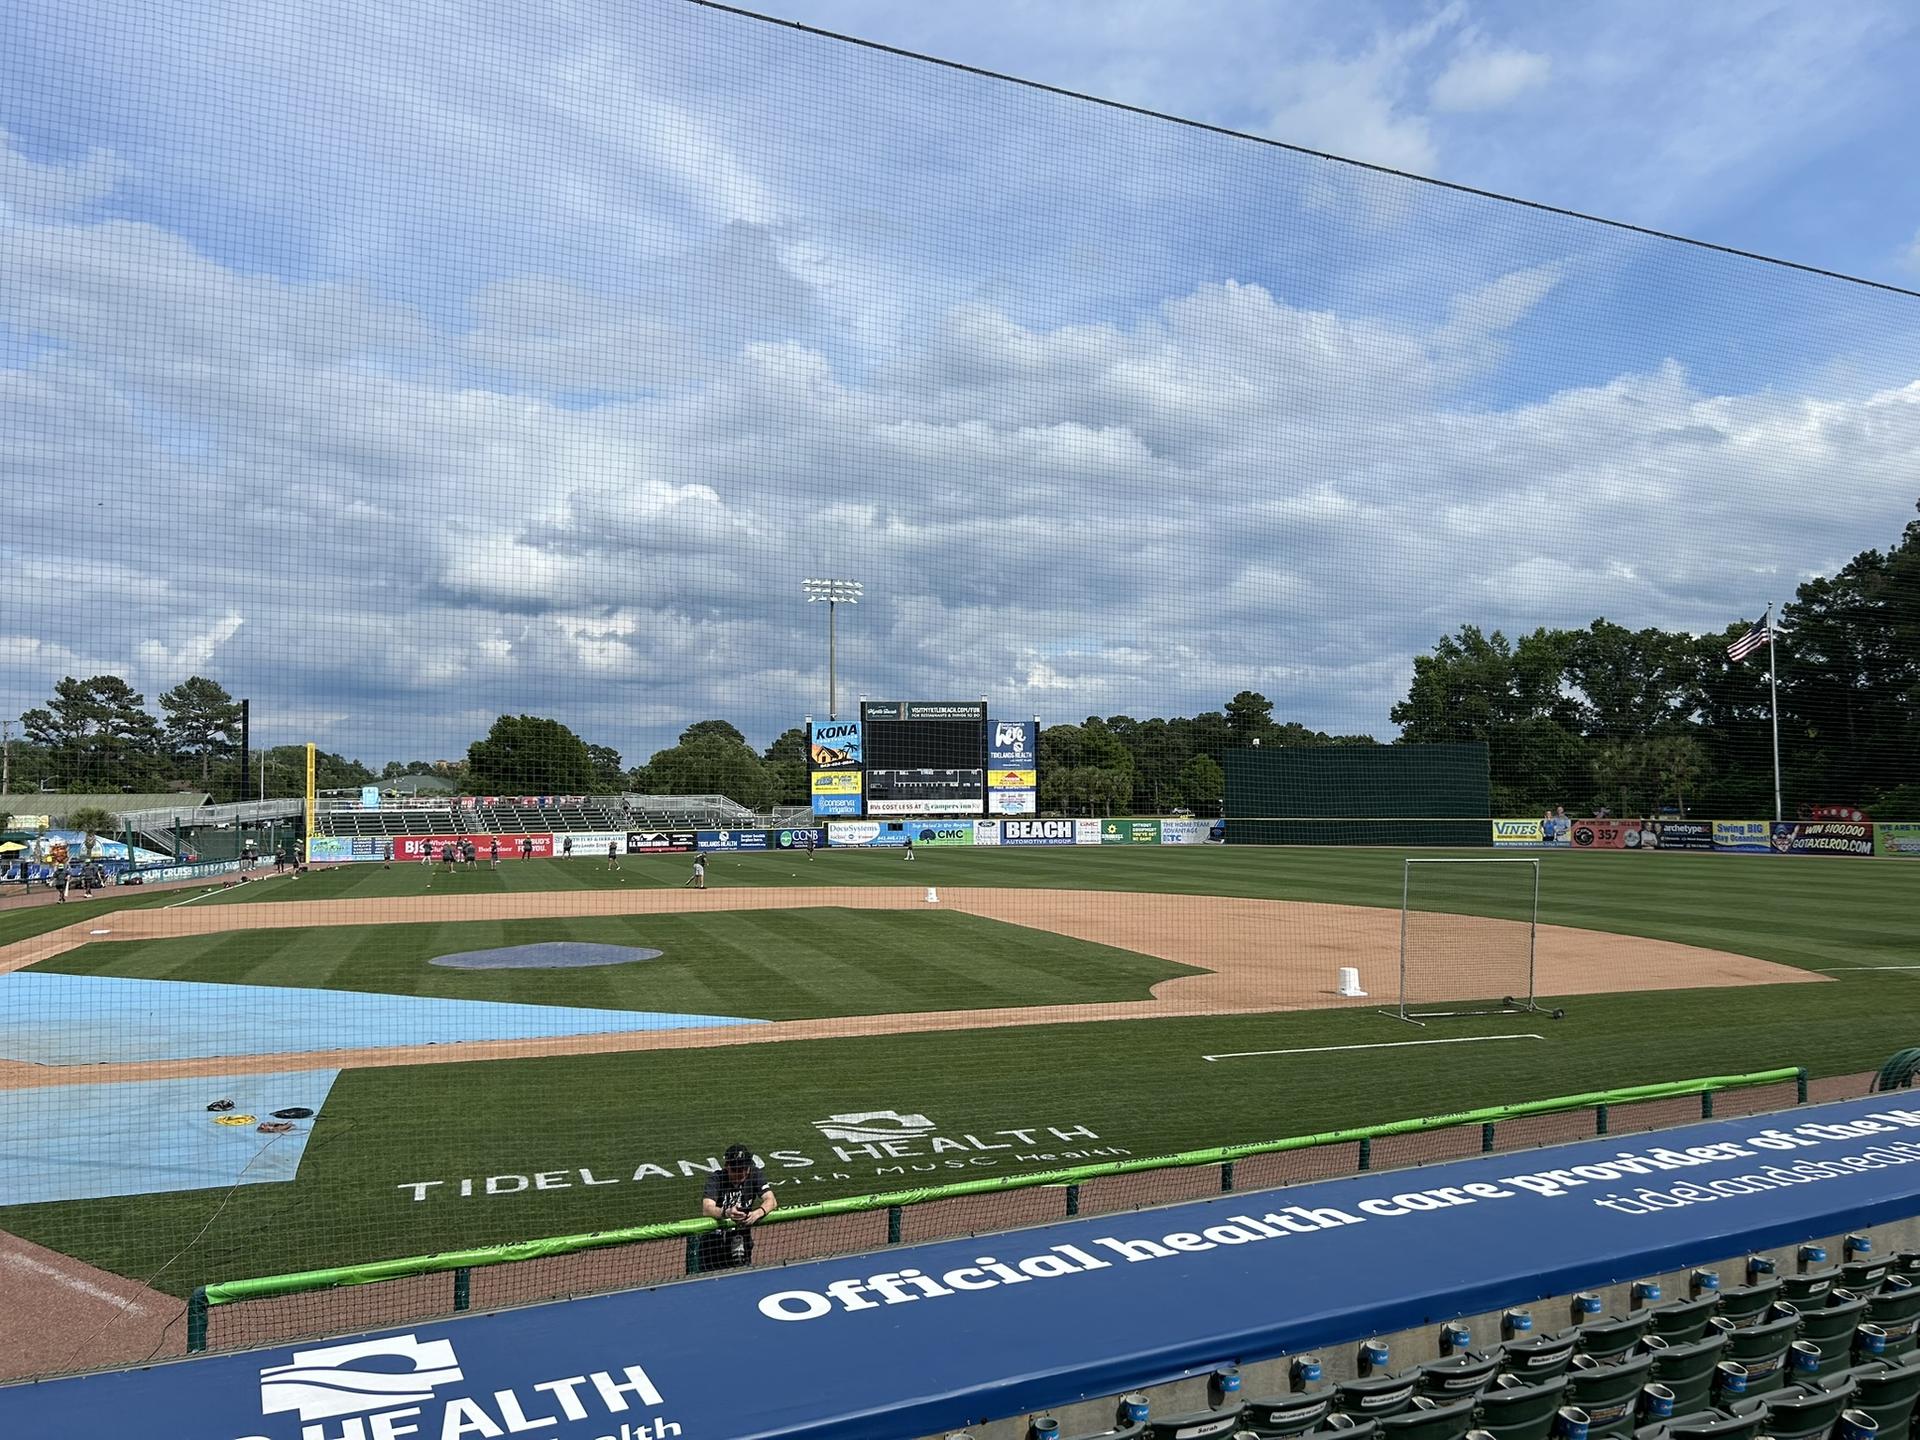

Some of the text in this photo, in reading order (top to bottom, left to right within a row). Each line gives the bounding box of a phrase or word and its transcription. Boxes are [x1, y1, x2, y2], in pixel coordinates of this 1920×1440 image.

[816, 724, 858, 740] KONA
[990, 751, 1014, 759] TIDELANDS
[829, 824, 878, 833] DocuSystems
[937, 829, 964, 839] CMC
[1005, 821, 1072, 838] BEACH
[1494, 821, 1538, 835] VINES
[1597, 829, 1619, 840] 357
[1717, 823, 1763, 836] Swing BIG
[1804, 823, 1865, 837] WIN $100,000
[792, 830, 818, 841] CCNB
[1792, 838, 1872, 855] GOTAXELROD.COM
[142, 869, 161, 880] SUN
[397, 1150, 815, 1201] TIDELANS
[831, 1125, 1100, 1162] HEALTH
[876, 1156, 998, 1176] MUSC
[1014, 1145, 1132, 1162] Health
[757, 1245, 1112, 1322] Official
[1092, 1205, 1365, 1263] health
[1357, 1178, 1506, 1218] care
[1499, 1136, 1759, 1198] provider
[1745, 1129, 1821, 1150] of
[1793, 1119, 1900, 1141] the
[1197, 1424, 1218, 1435] Sarah
